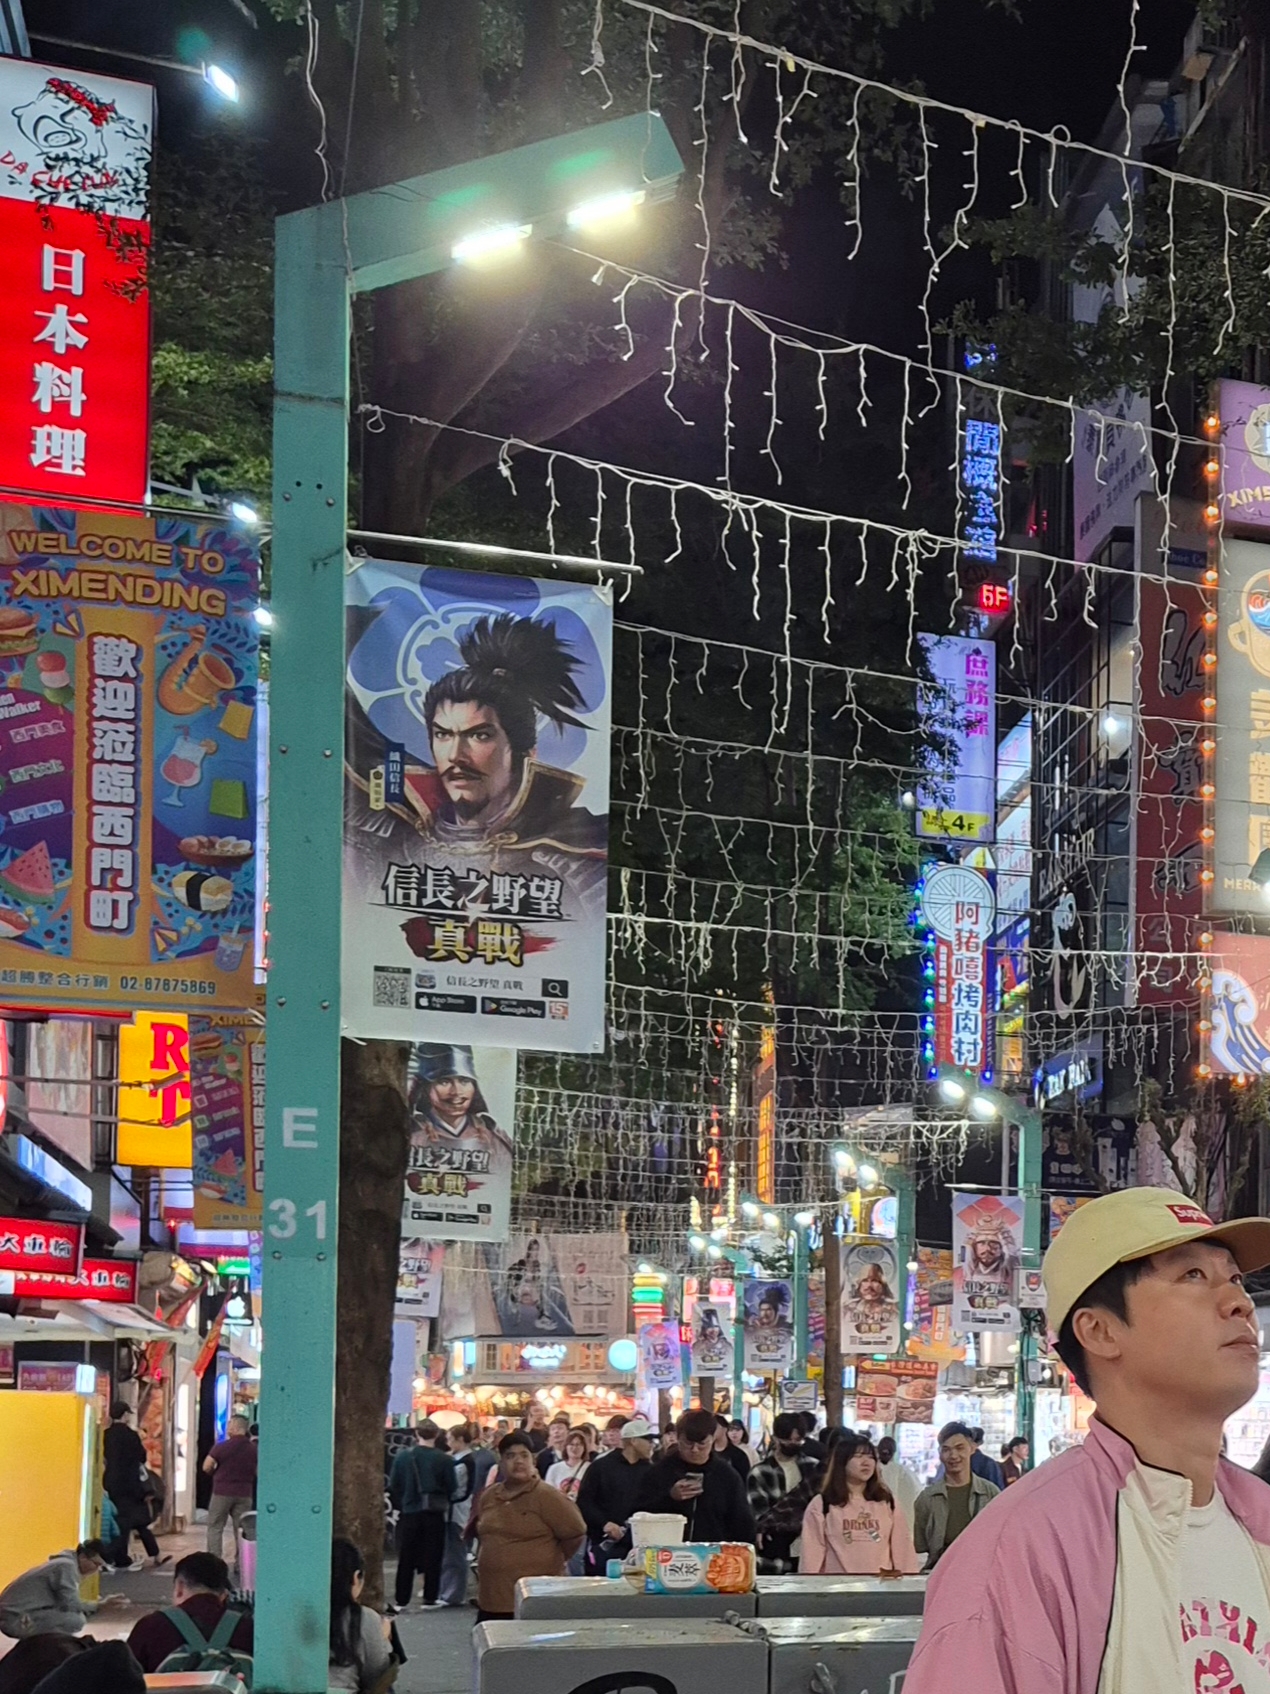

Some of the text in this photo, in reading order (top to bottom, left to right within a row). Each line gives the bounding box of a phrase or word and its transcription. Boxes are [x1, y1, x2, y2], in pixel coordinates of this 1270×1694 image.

[30, 243, 89, 478] 日本料理
[9, 530, 224, 574] WELCOME TO
[11, 569, 227, 616] XIMENDING
[91, 635, 138, 930] 歡迎蒞臨西門町
[384, 863, 563, 917] 信長之野望
[427, 918, 522, 966] 真戰
[119, 975, 217, 996] 02-87875869
[282, 1108, 318, 1149] E
[268, 1198, 328, 1240] 31
